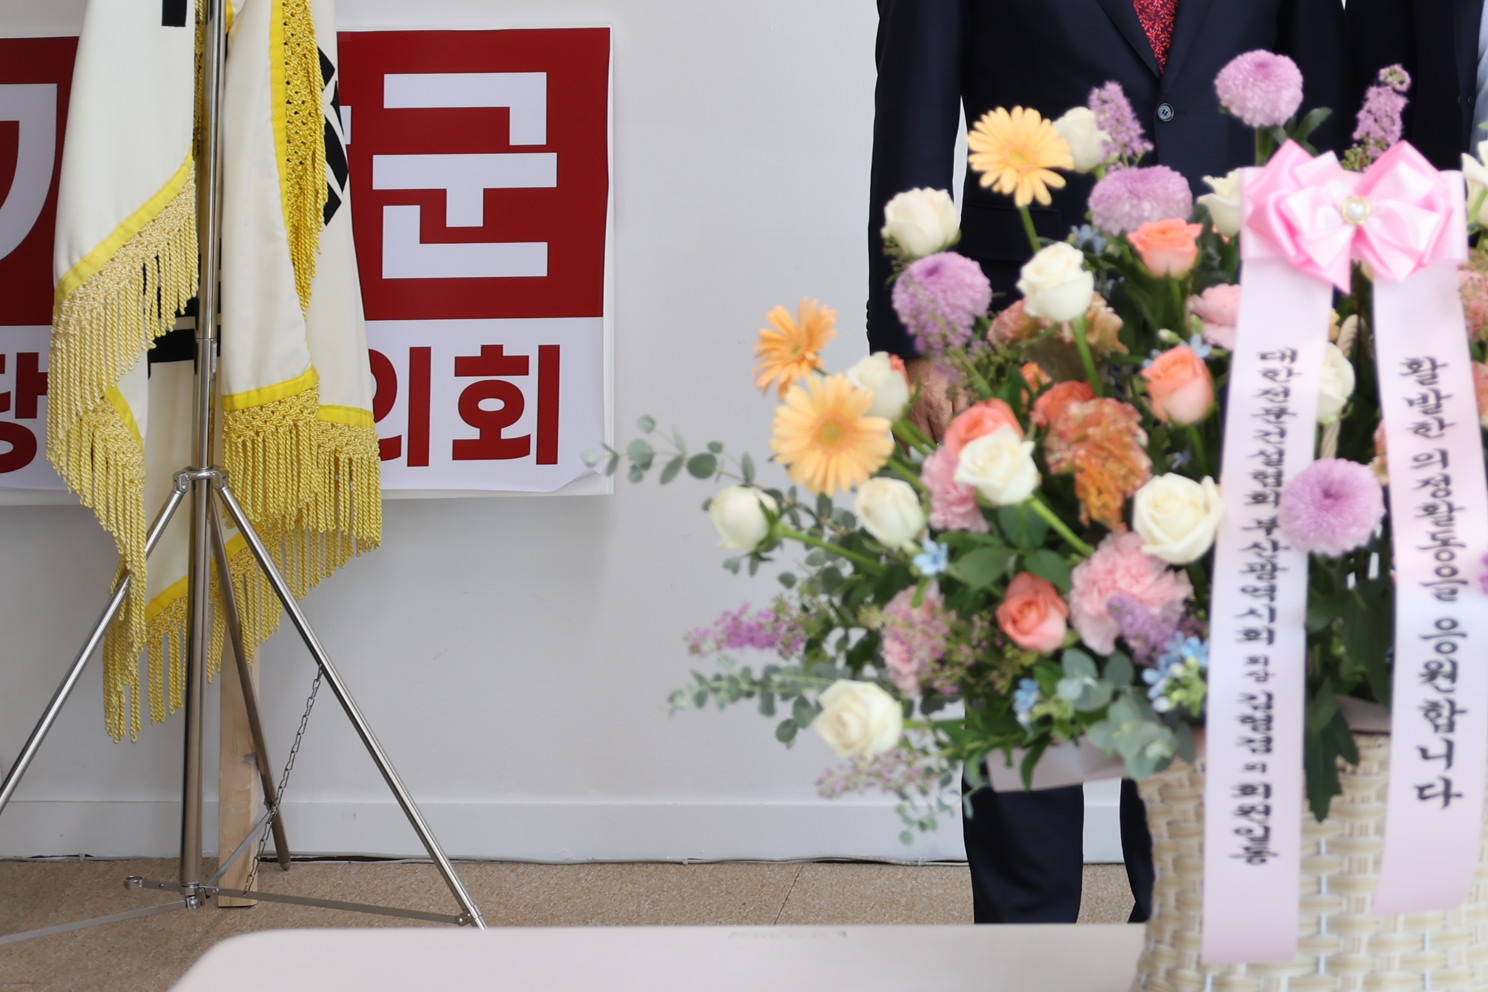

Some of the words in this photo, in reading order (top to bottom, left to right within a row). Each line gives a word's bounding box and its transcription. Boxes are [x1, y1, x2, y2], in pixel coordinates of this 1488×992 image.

[342, 72, 558, 279] 군
[1245, 347, 1303, 508] 대한전문건설협회
[1398, 356, 1457, 440] 활발한
[1409, 447, 1469, 603] 의정활동을
[1413, 616, 1469, 811] 응원합니다
